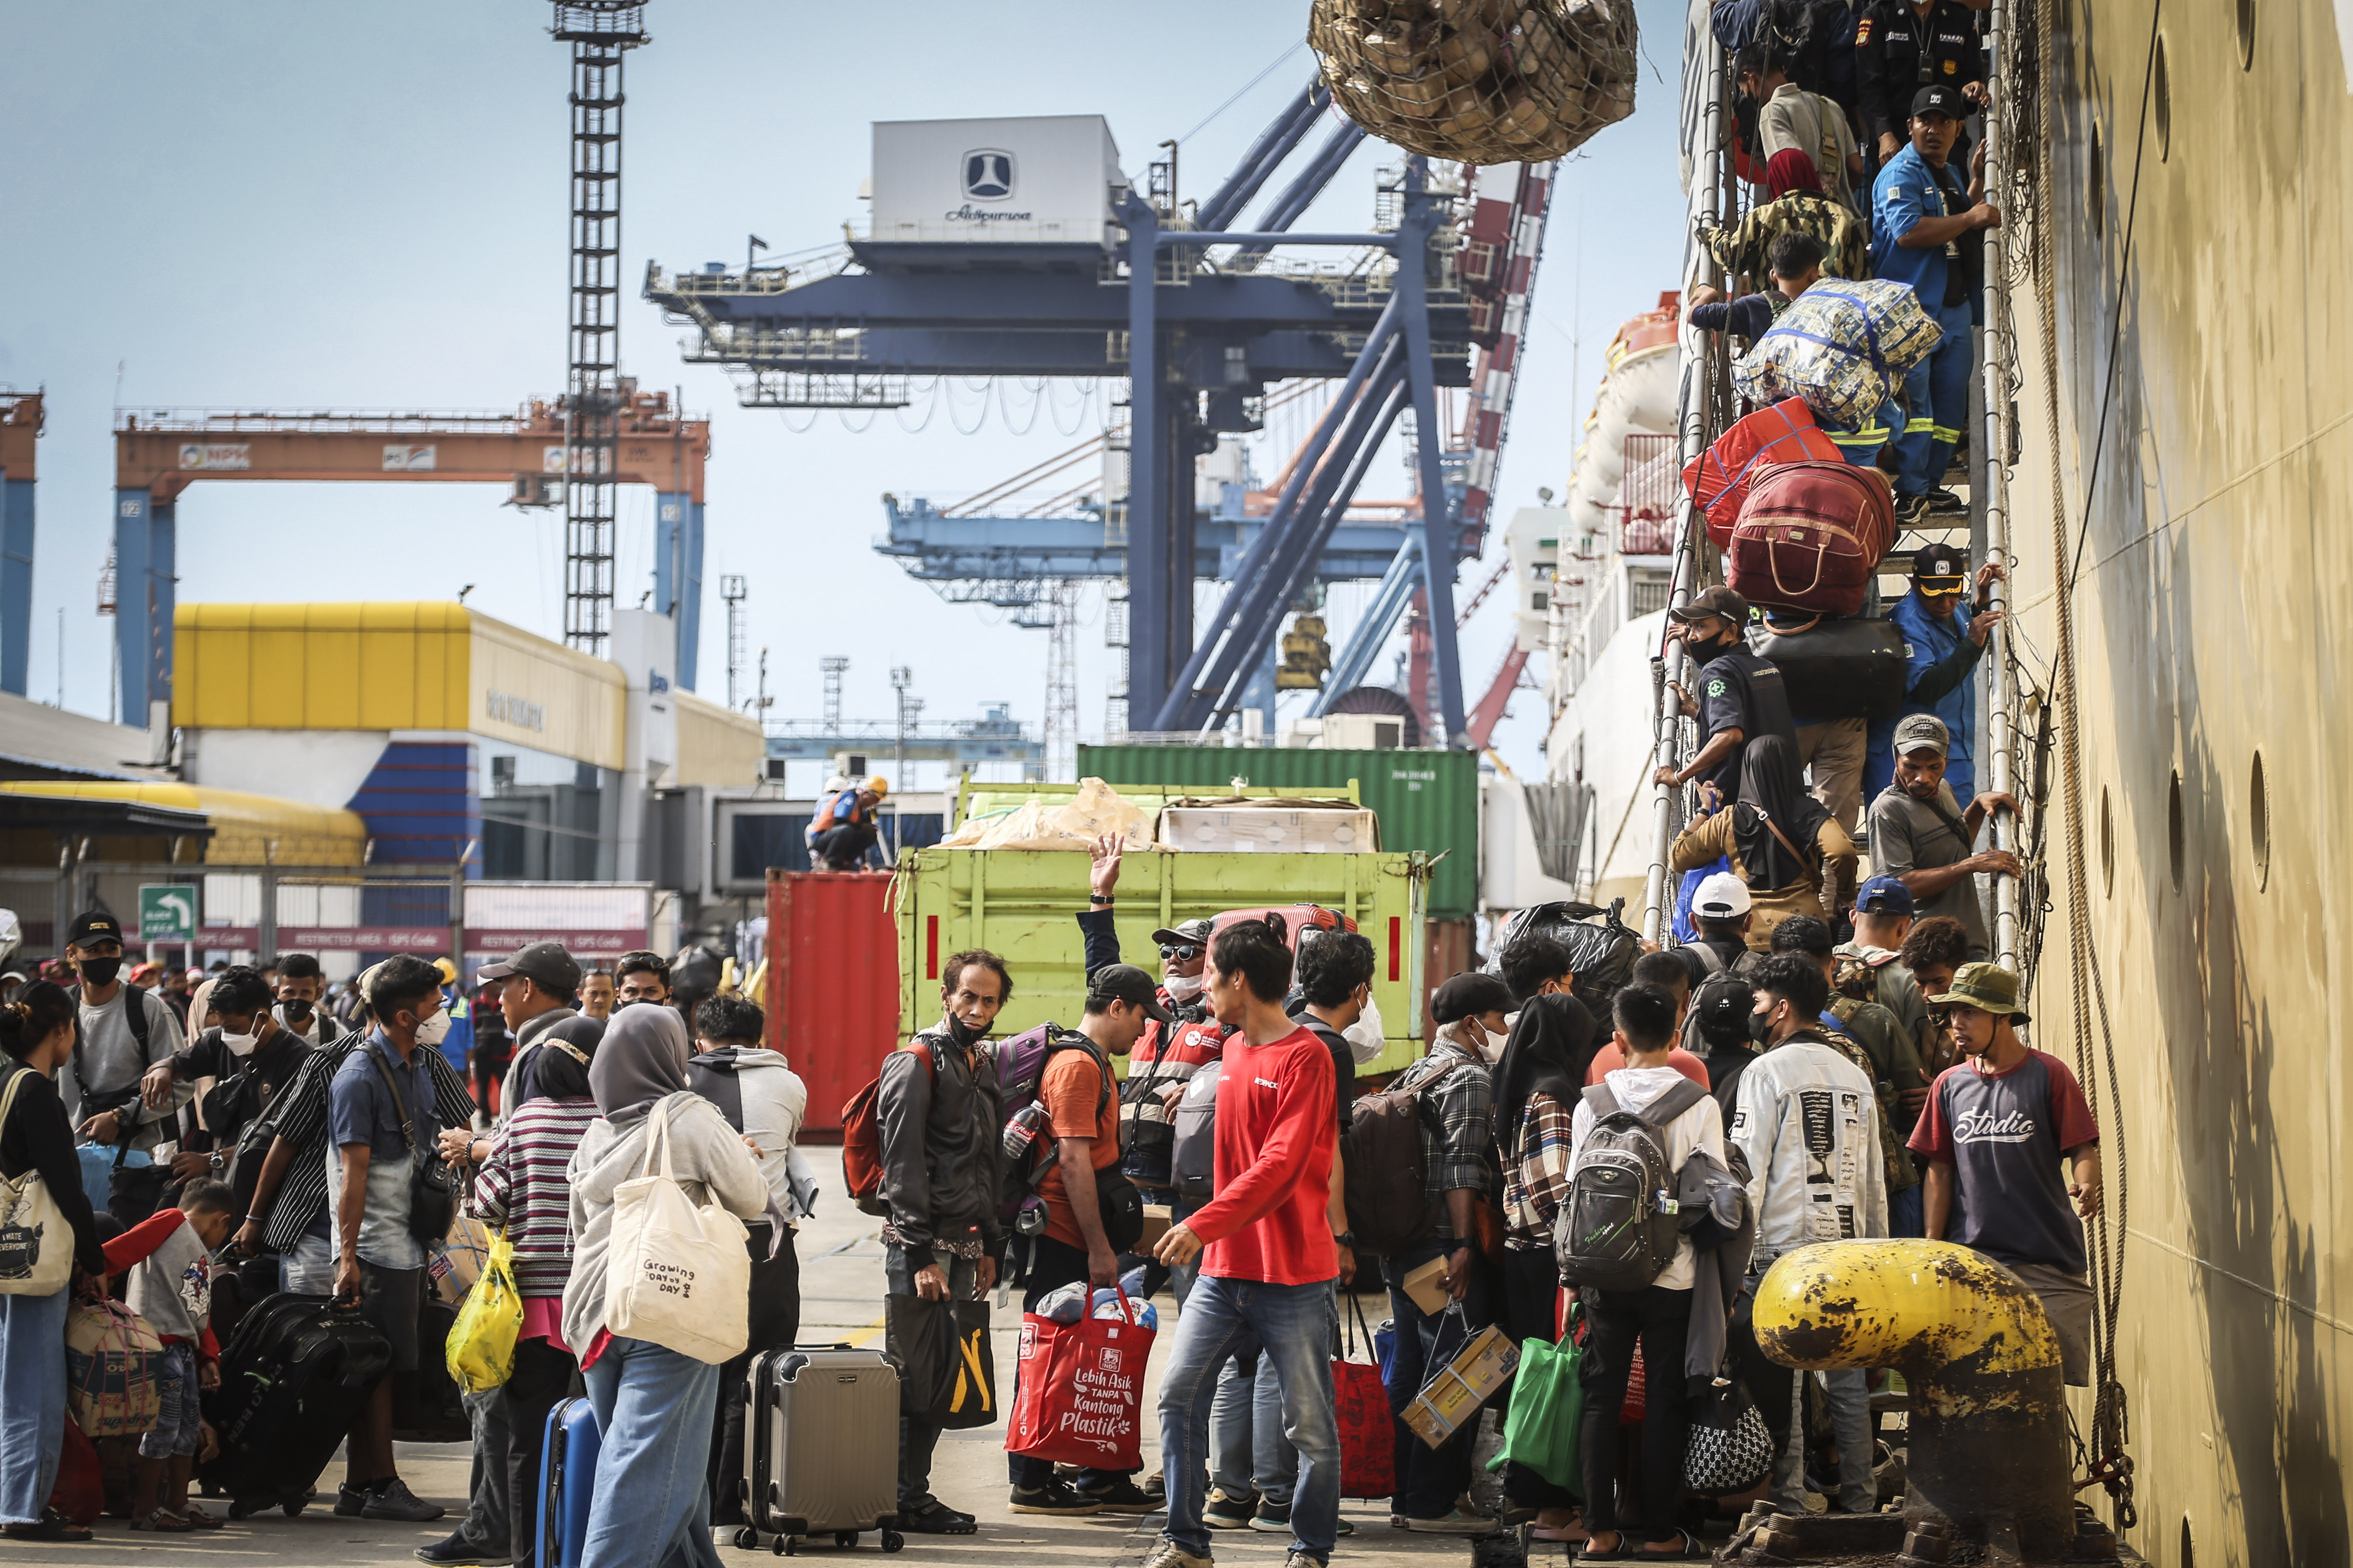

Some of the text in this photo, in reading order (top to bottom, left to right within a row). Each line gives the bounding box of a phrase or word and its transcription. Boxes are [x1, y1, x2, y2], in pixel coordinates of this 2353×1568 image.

[295, 933, 352, 946] RESTRICTED
[354, 933, 382, 946] AREA
[411, 933, 438, 947] Code
[597, 935, 624, 948] Code
[1254, 1077, 1278, 1089] REDPACK
[1953, 1106, 2035, 1144] Studio
[0, 1243, 28, 1251] EVERYONE
[643, 1259, 694, 1281] Growing
[649, 1273, 668, 1282] DAY
[660, 1284, 680, 1295] DAY
[1075, 1368, 1132, 1390] Lebih Asik
[1092, 1388, 1119, 1399] TANPA
[1457, 1390, 1470, 1401] Deligh
[1074, 1394, 1124, 1420] Kantong
[1060, 1412, 1117, 1438] Plastik
